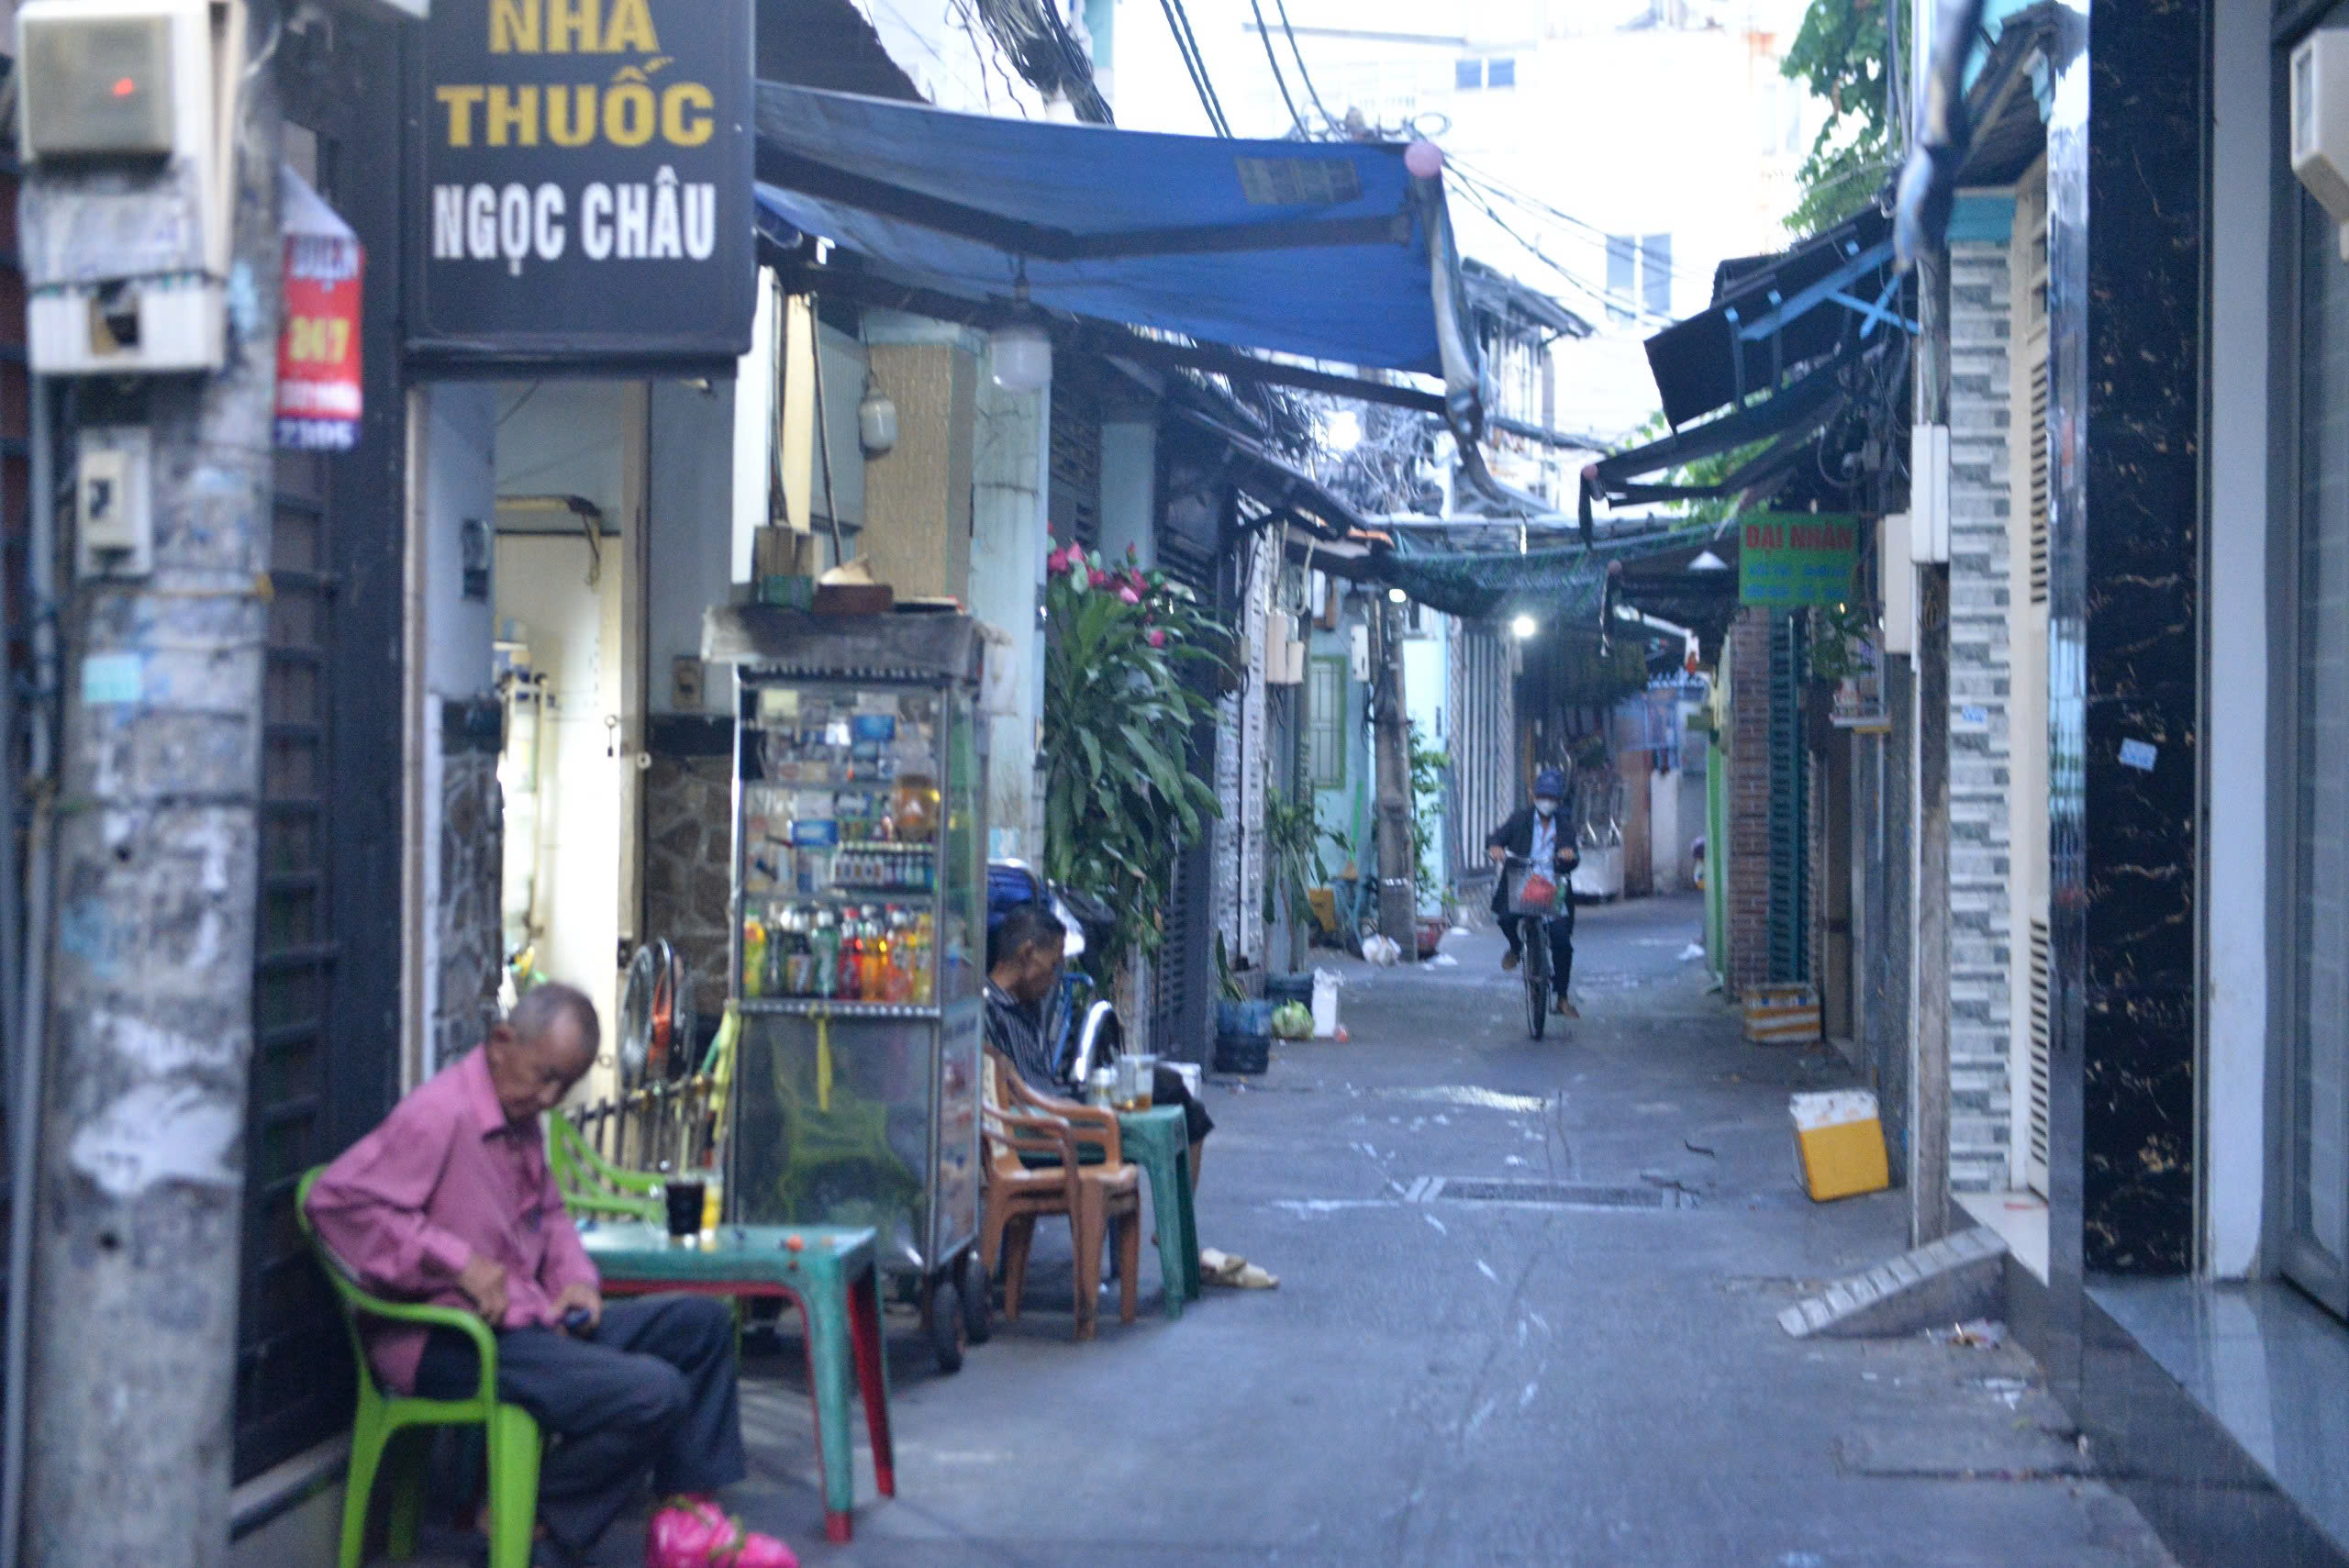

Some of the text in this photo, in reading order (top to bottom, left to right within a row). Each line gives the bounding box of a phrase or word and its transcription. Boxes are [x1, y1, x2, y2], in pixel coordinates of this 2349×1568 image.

[436, 56, 716, 147] THUỐC
[432, 165, 716, 276] NGỌC CHÂU
